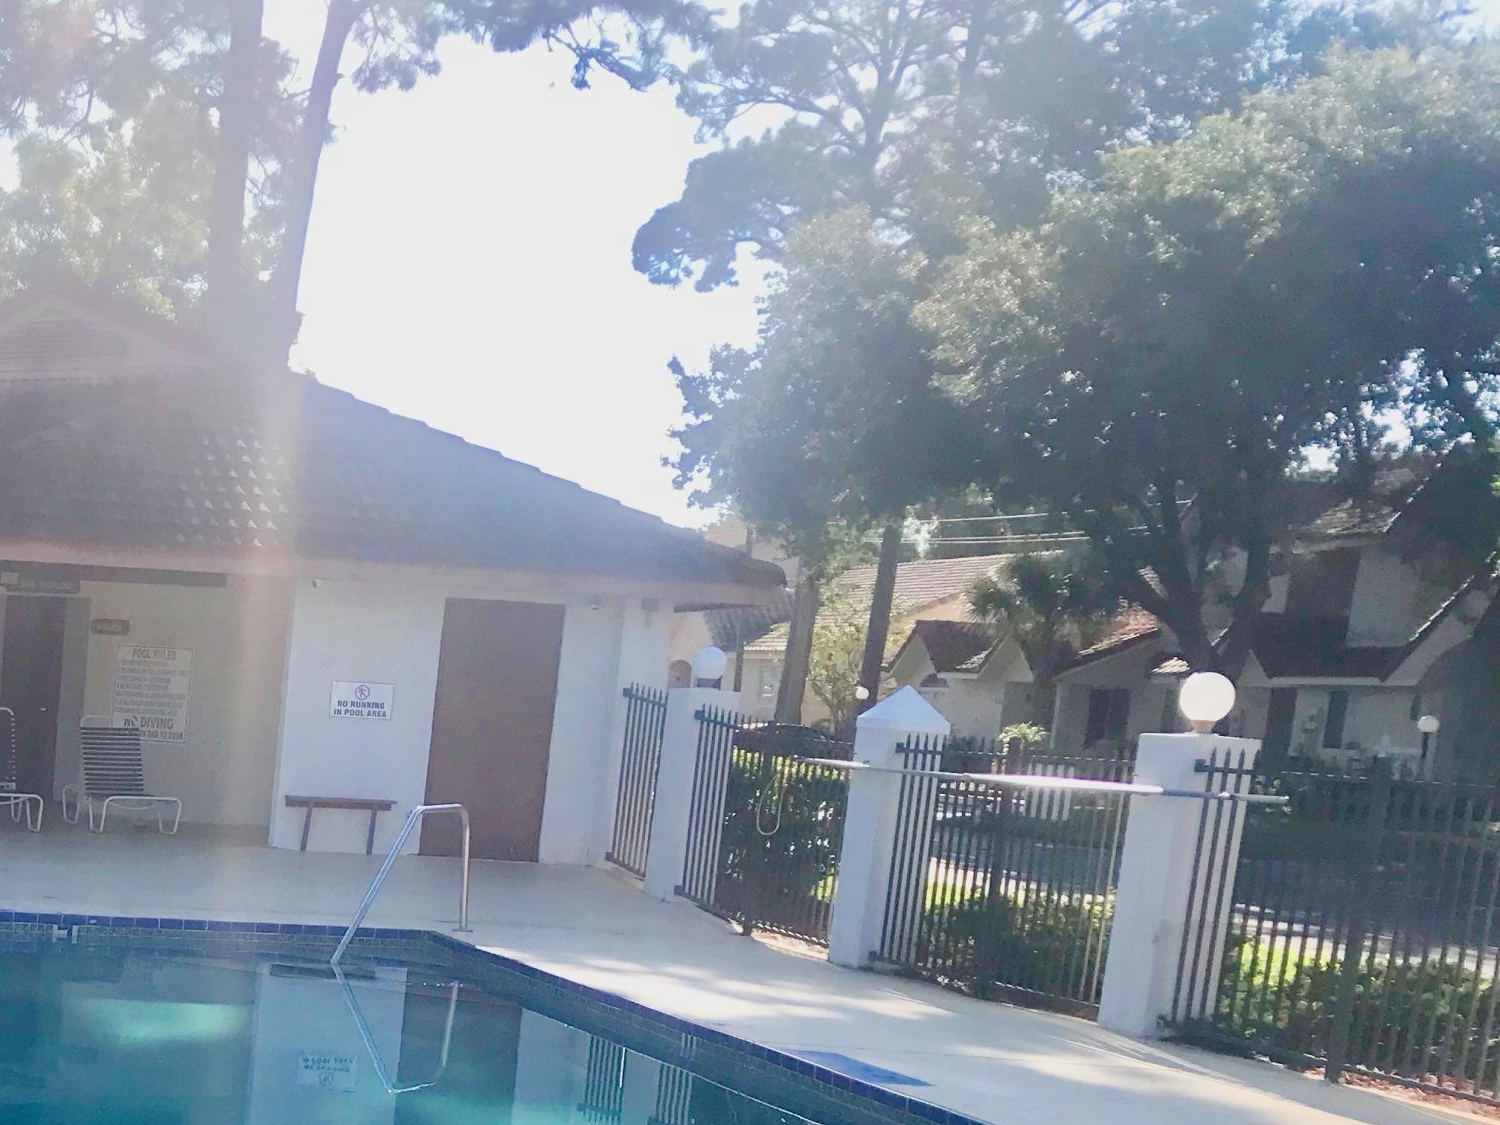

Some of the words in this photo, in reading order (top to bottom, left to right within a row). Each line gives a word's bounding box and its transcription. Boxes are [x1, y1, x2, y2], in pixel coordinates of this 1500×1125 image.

[337, 700, 348, 708] NO
[350, 700, 385, 709] RUNNING
[344, 708, 364, 717] POOL
[366, 709, 386, 718] AREA
[124, 715, 137, 727] NO
[140, 715, 174, 729] DIVING
